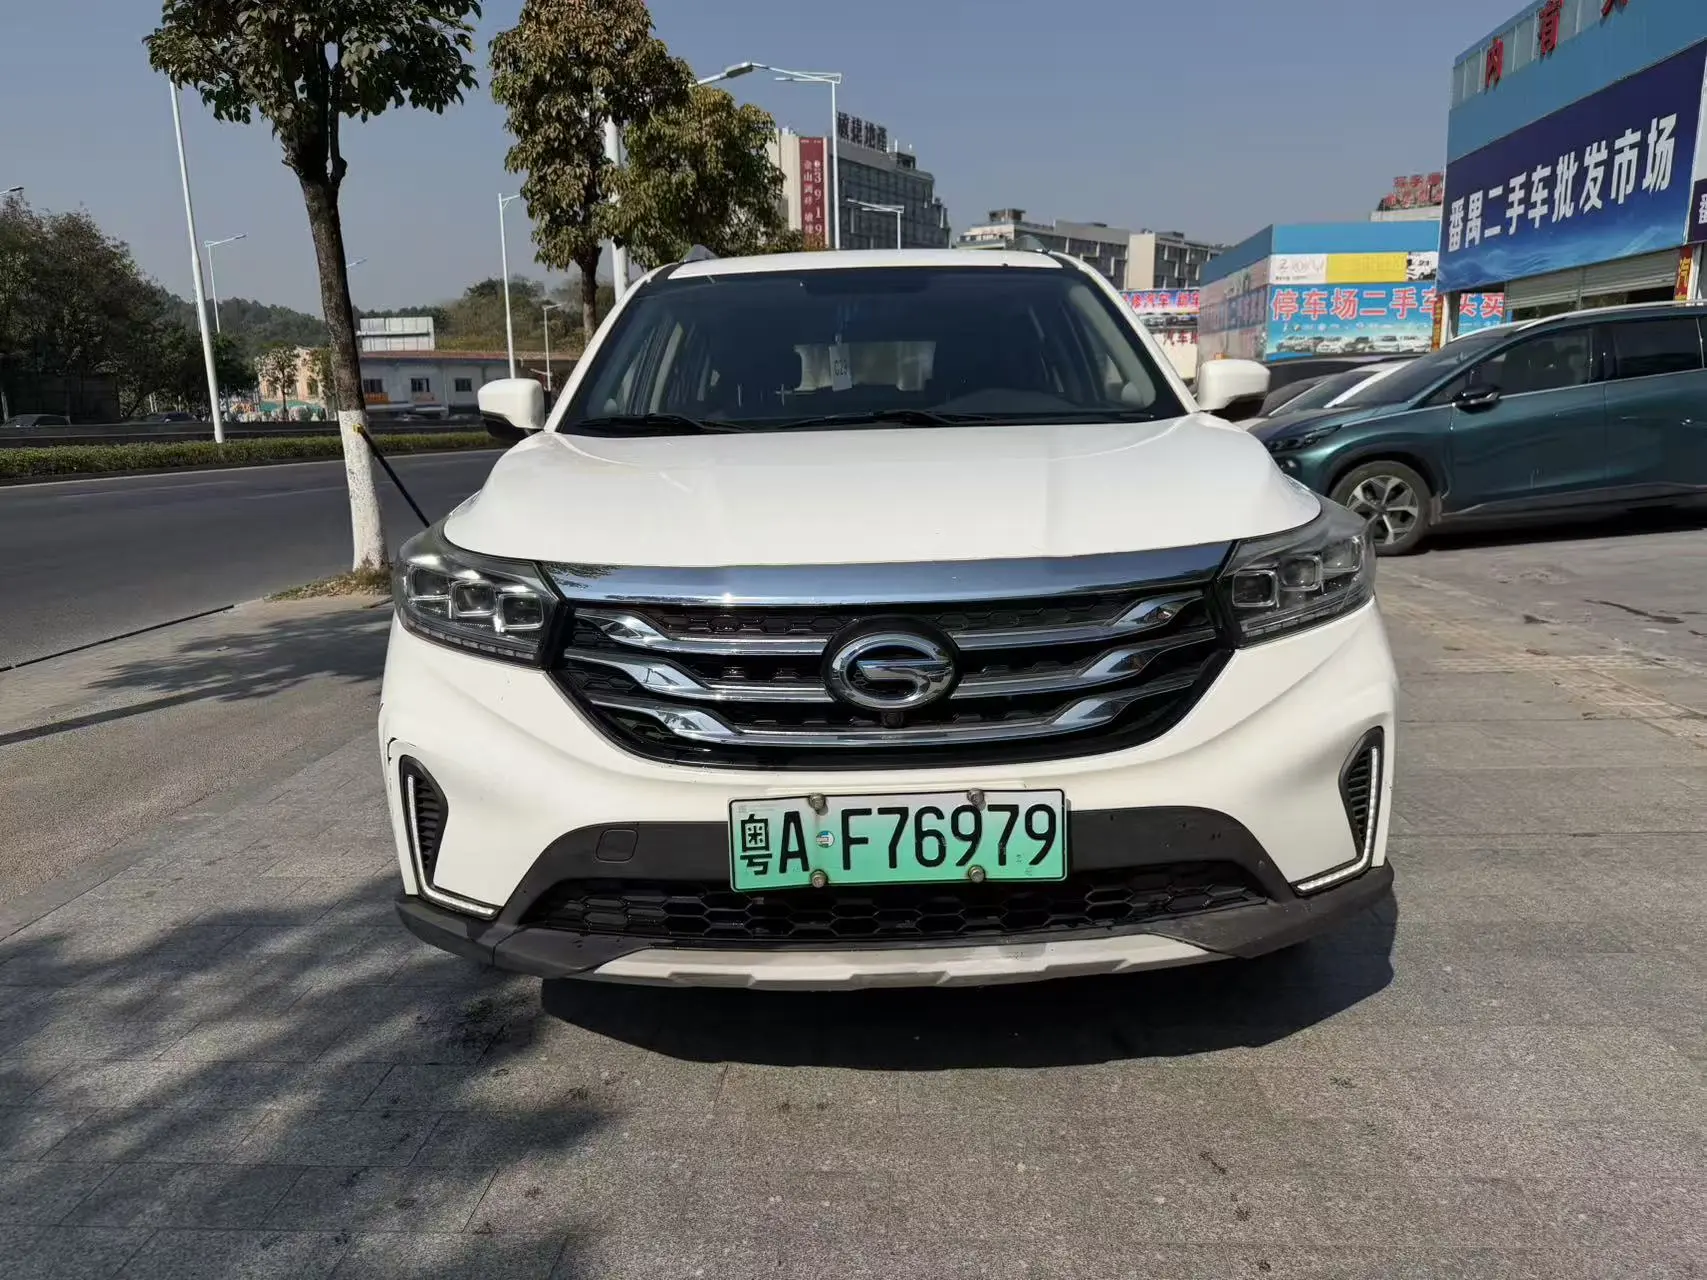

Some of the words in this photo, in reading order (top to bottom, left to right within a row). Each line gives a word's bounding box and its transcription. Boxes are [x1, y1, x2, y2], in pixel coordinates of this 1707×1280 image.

[1448, 113, 1678, 252] 番禺二手车批发市场
[740, 810, 810, 875] 粤A
[841, 803, 1056, 871] F76979
